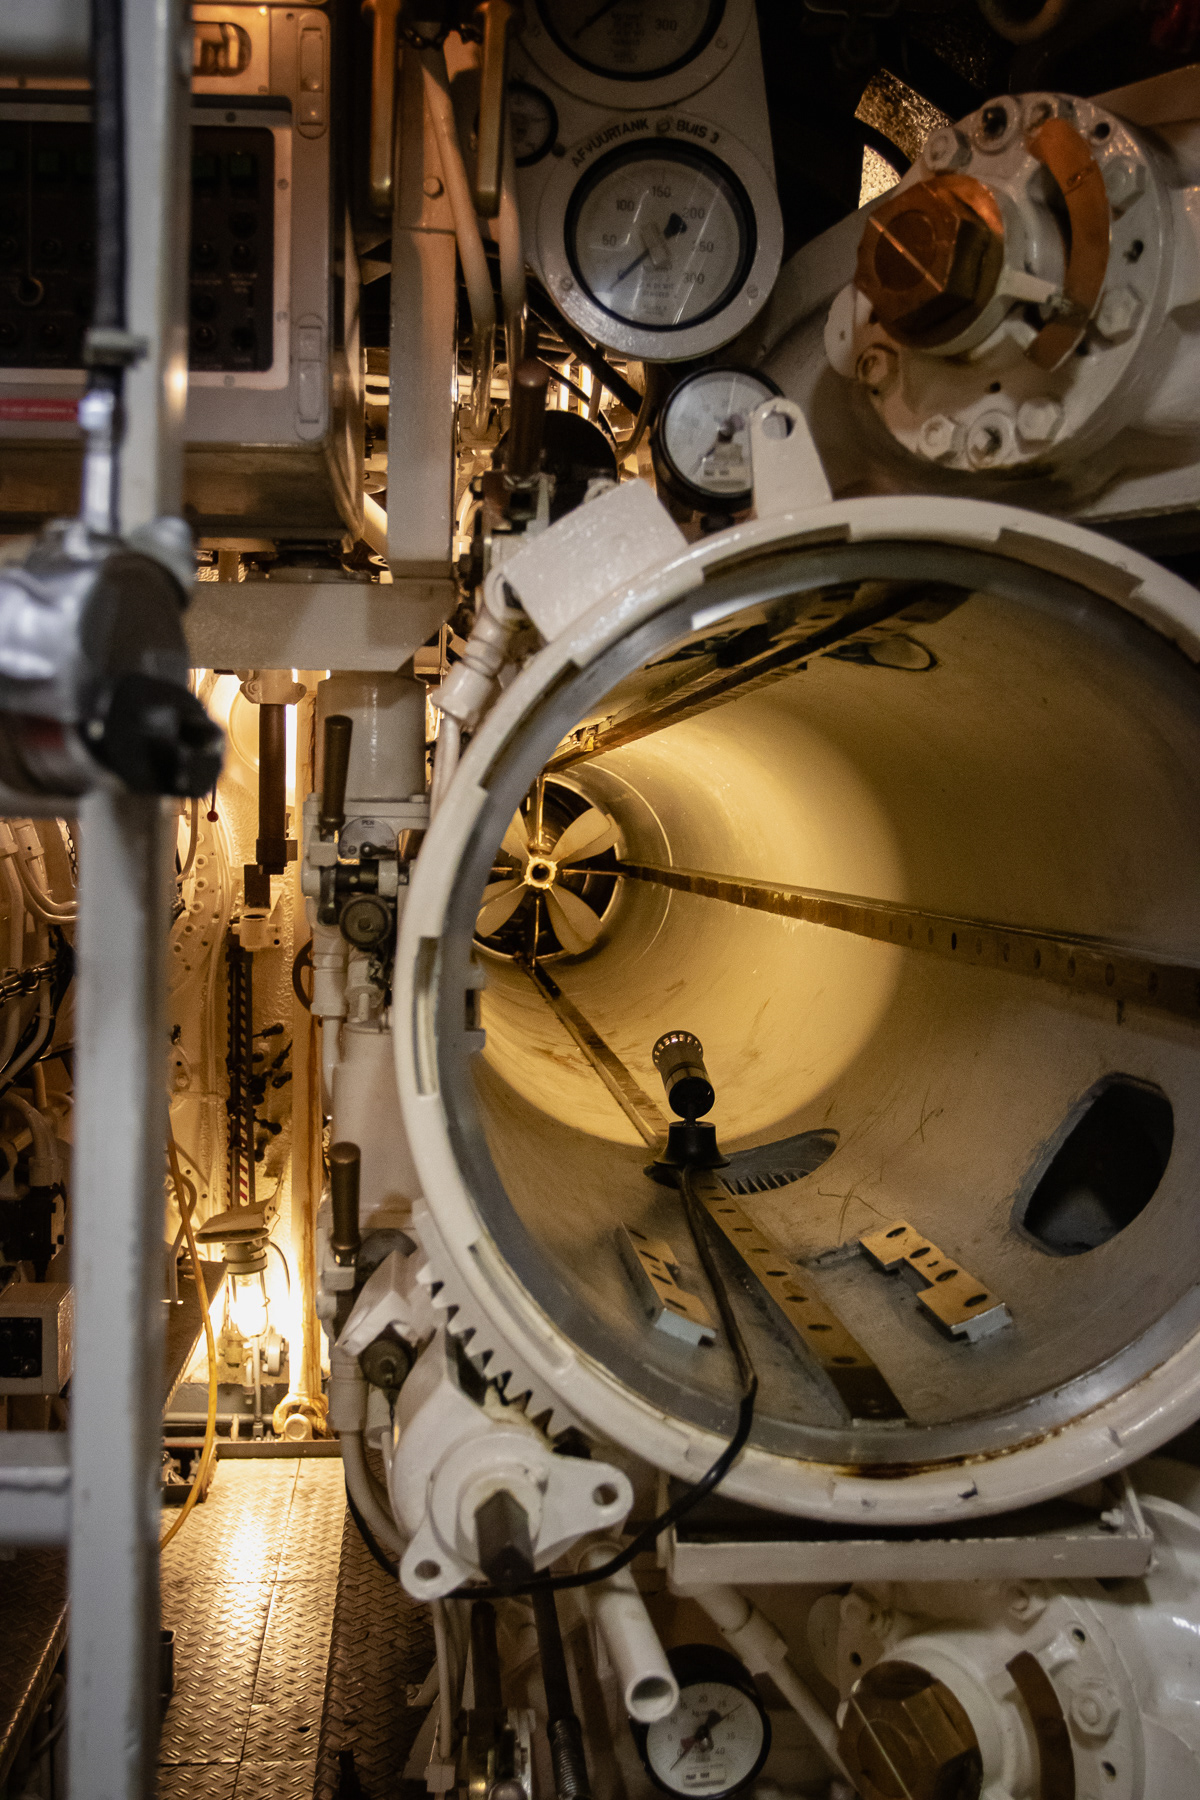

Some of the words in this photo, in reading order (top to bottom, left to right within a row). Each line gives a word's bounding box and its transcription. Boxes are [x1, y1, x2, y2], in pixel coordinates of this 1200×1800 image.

[655, 18, 677, 31] 300
[571, 118, 649, 168] AFVUURTANK
[676, 119, 708, 138] BUIS
[709, 131, 721, 144] 3
[652, 186, 671, 198] 150
[616, 200, 635, 212] 100
[682, 207, 705, 219] 200
[602, 233, 617, 247] 50
